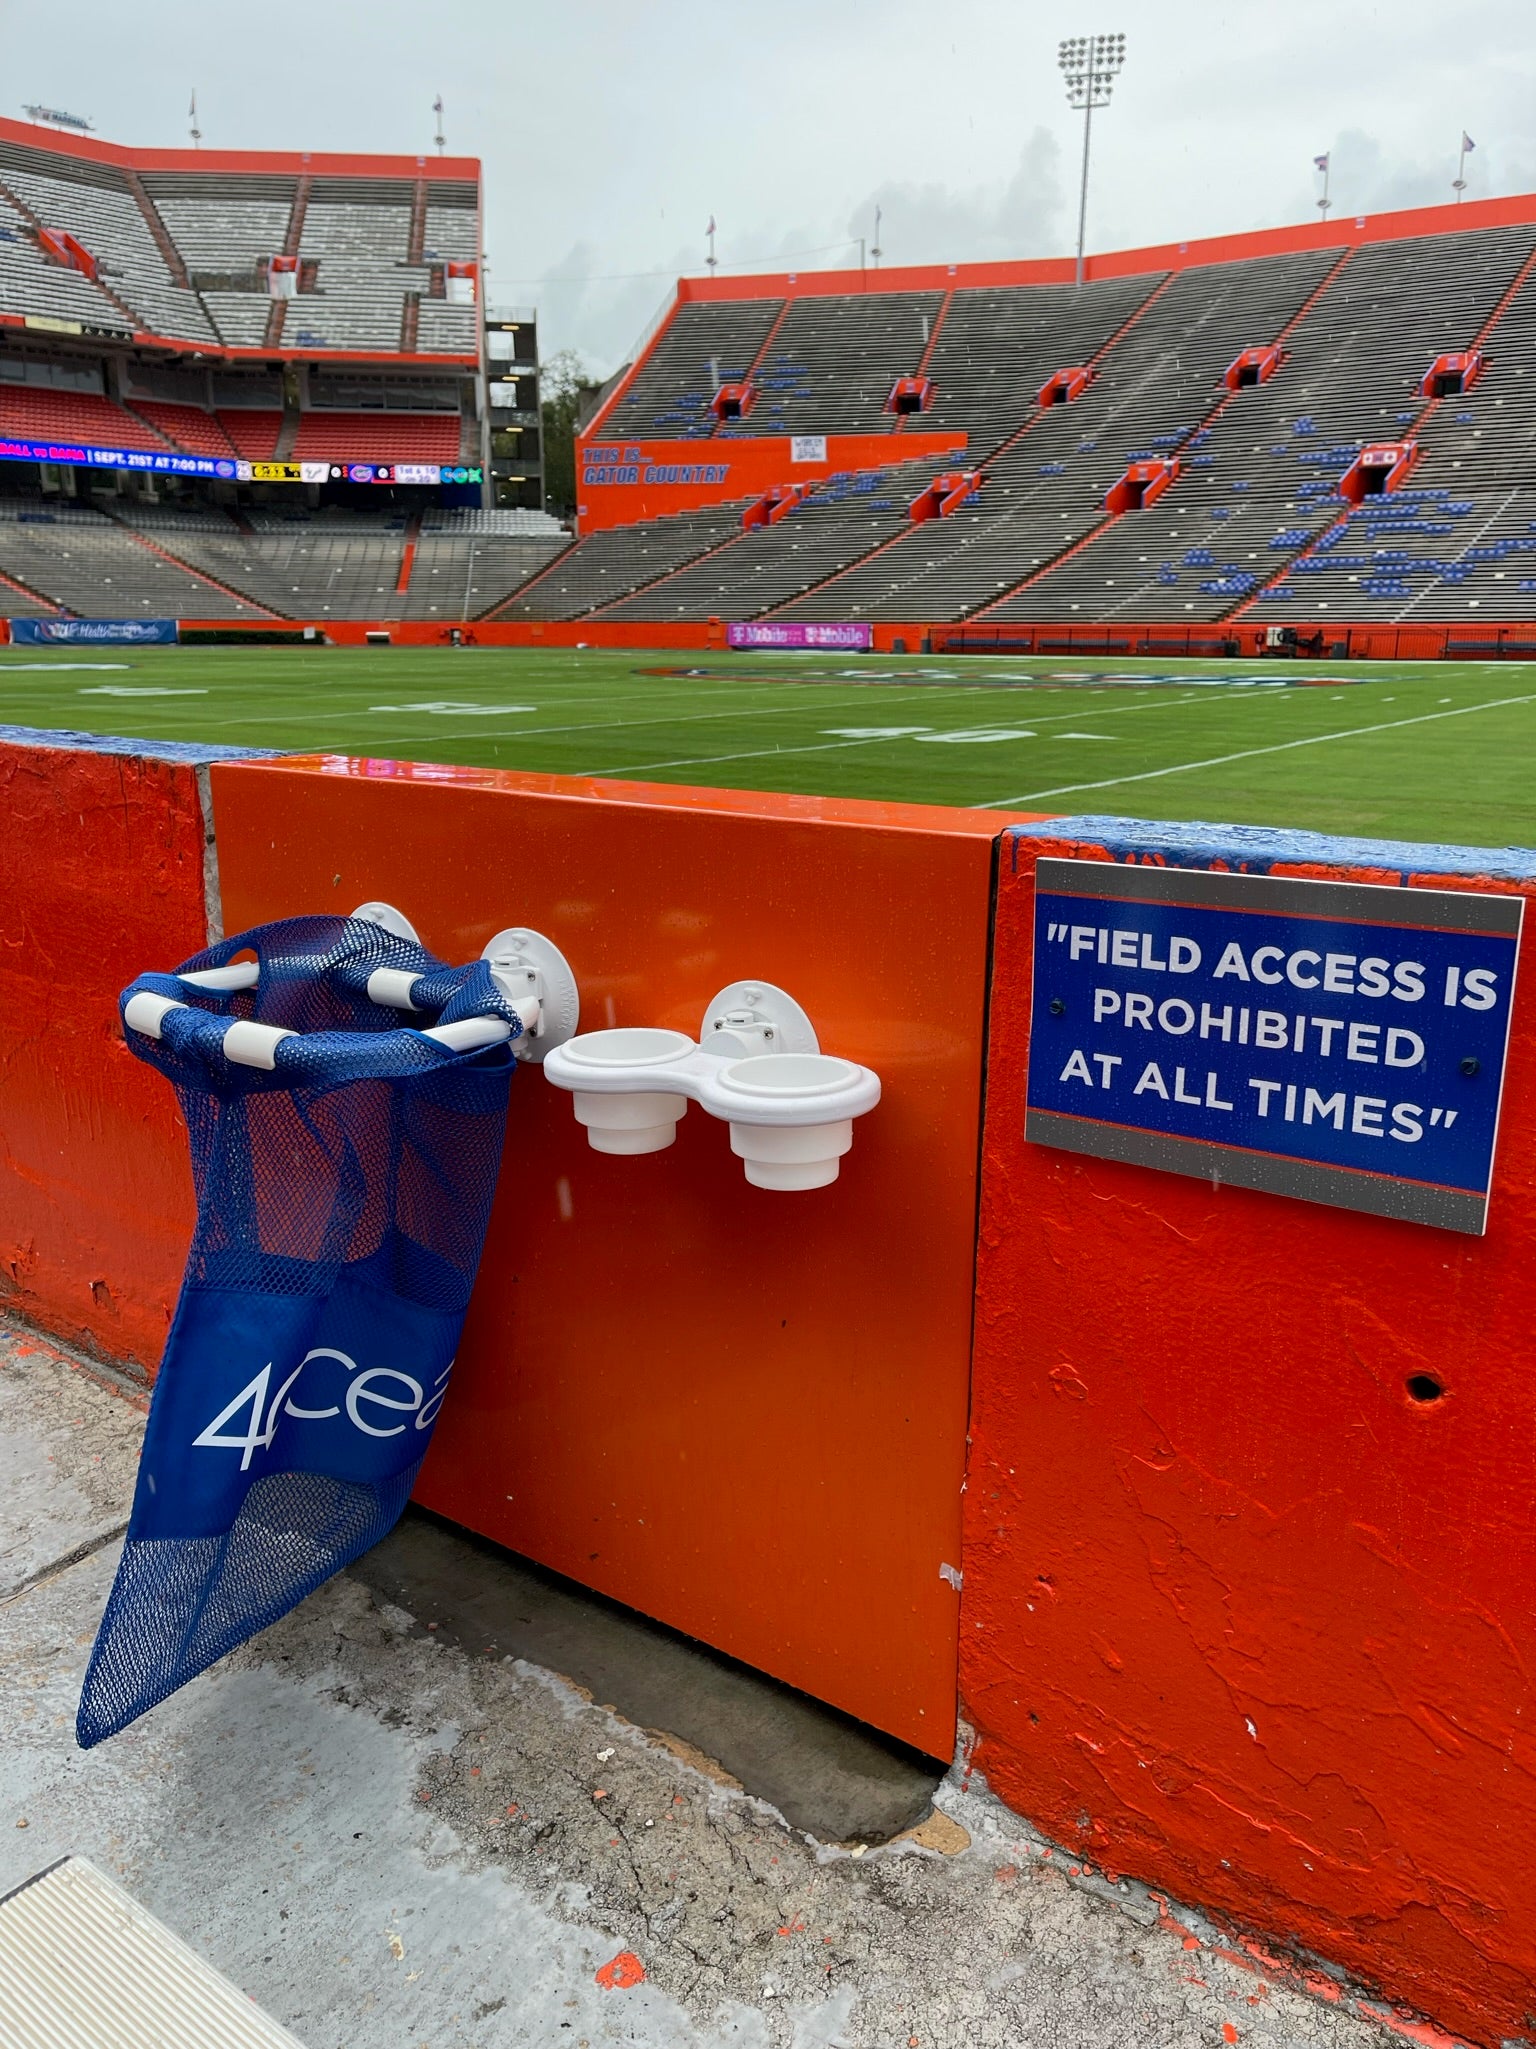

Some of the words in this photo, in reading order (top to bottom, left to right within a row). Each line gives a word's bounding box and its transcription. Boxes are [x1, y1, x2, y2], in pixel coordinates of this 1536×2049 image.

[94, 450, 127, 465] SEPT.
[128, 454, 153, 467] 21ST
[155, 457, 170, 469] AT
[171, 458, 197, 472] 7:00
[197, 460, 214, 473] PM
[583, 447, 618, 464] THIS
[584, 465, 639, 485] GATOR
[644, 464, 731, 484] COUNTRY
[819, 627, 864, 643] Mobile
[1047, 922, 1202, 974] "FIELD
[1212, 942, 1426, 1002] ACCESS
[1443, 966, 1498, 1011] IS
[1093, 988, 1426, 1069] PROHIBITED
[1058, 1049, 1123, 1090] AT
[1133, 1062, 1234, 1112] ALL
[1248, 1078, 1459, 1144] TIMES"
